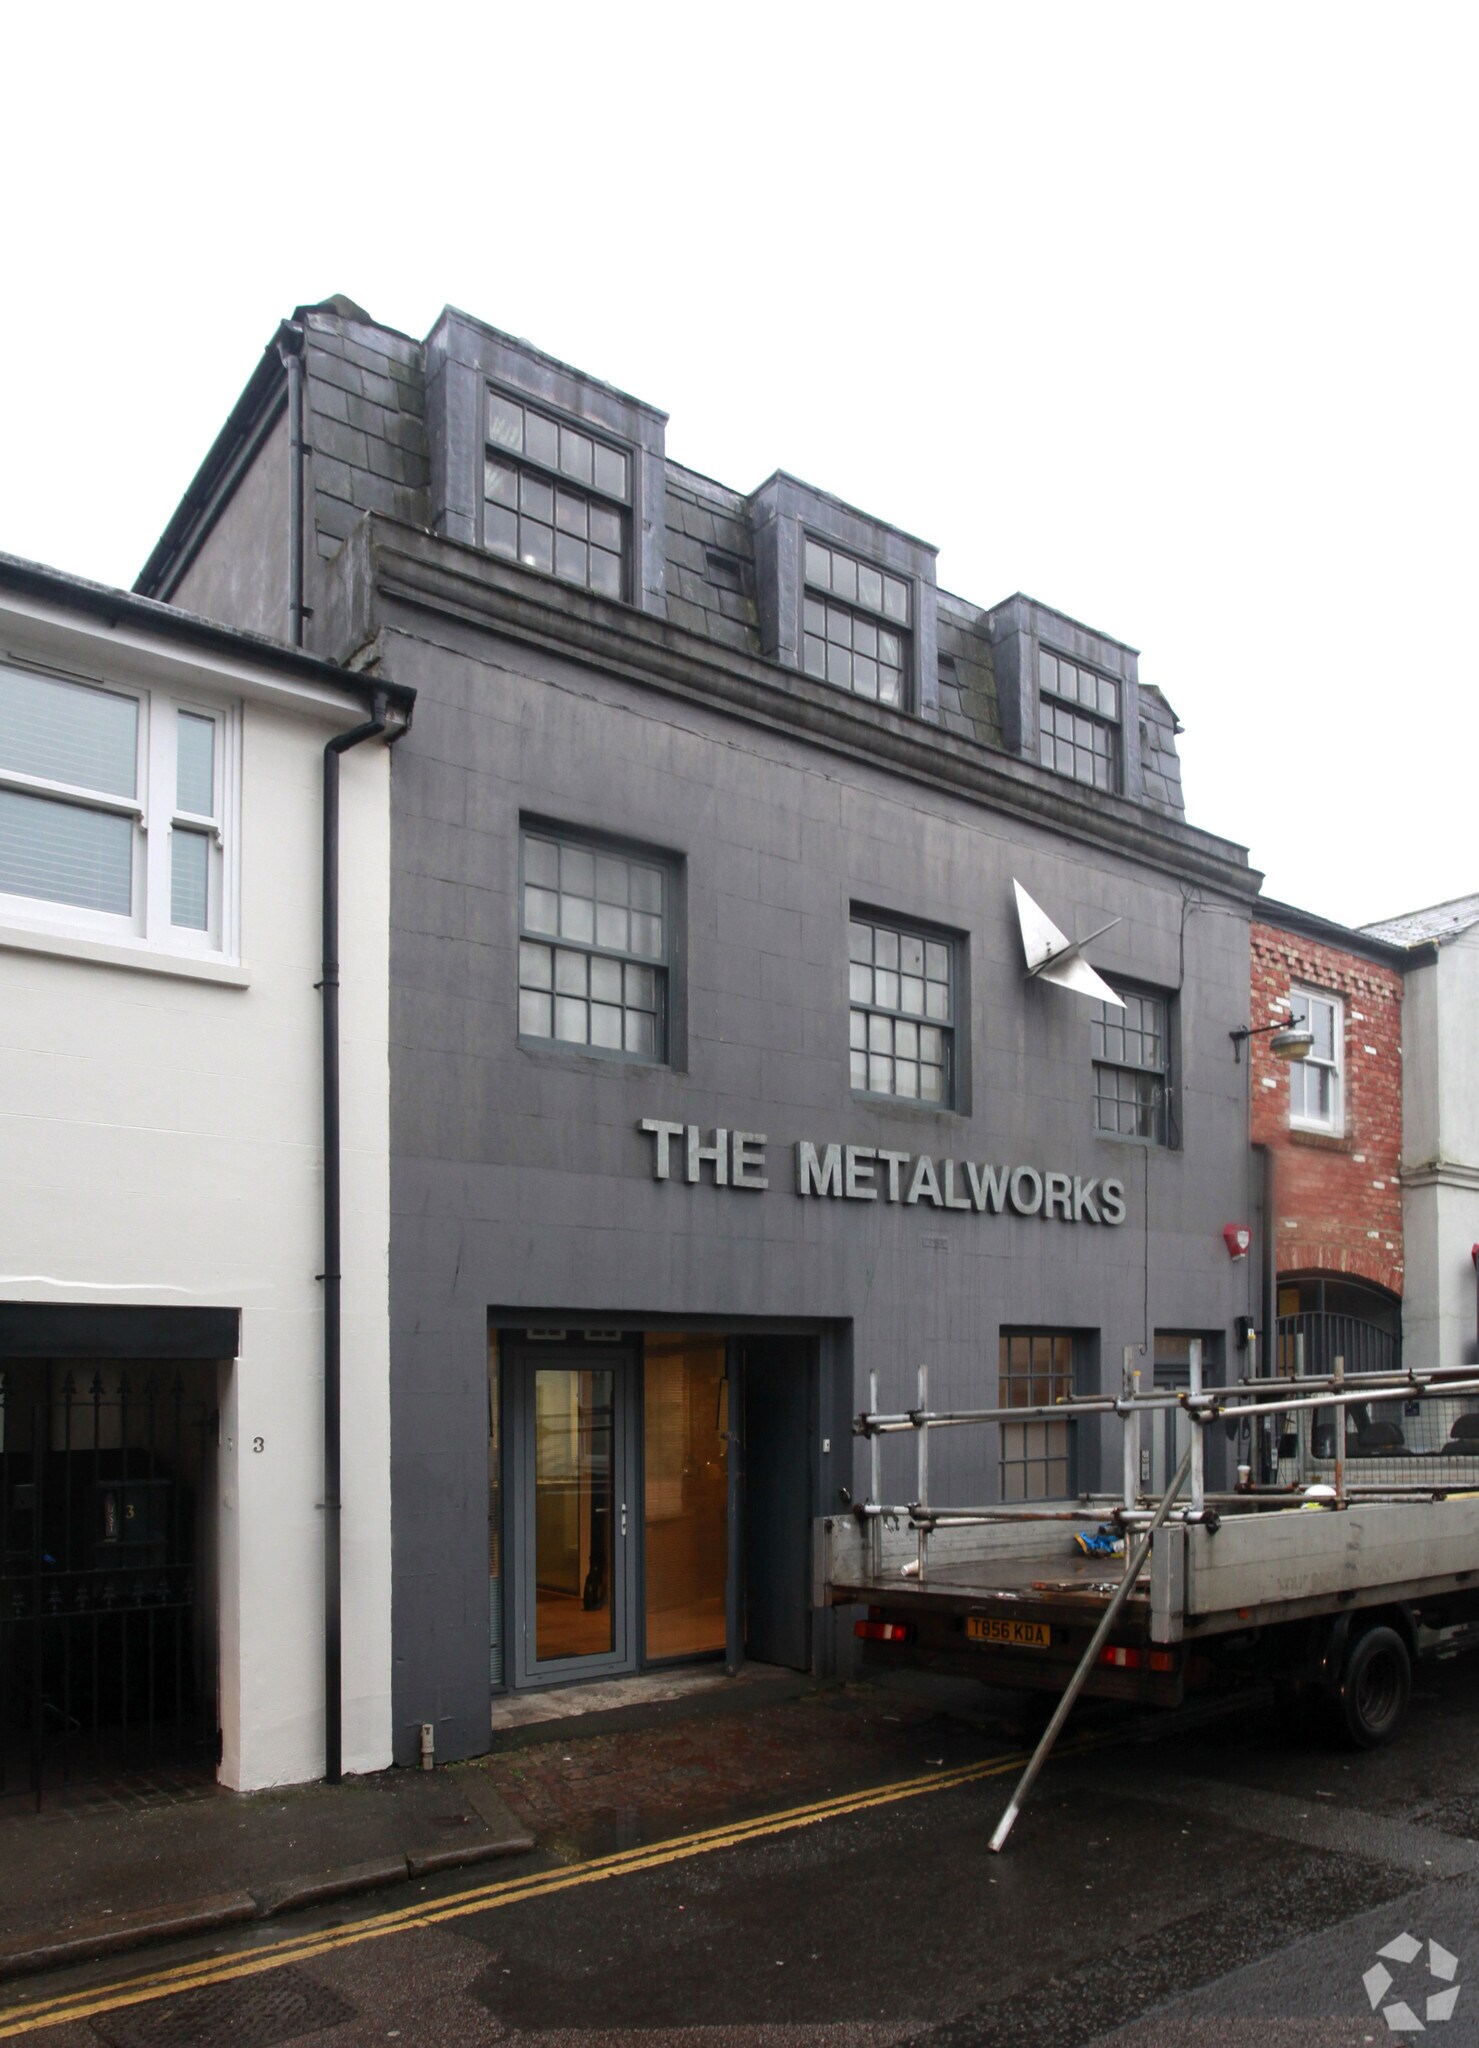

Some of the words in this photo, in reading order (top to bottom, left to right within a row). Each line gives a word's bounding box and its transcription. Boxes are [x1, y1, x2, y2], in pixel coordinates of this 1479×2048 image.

[638, 1118, 769, 1189] THE
[795, 1140, 1127, 1226] METALWORKS
[253, 1436, 265, 1454] 3
[126, 1504, 135, 1519] 3
[972, 1618, 1010, 1639] T856
[1014, 1622, 1044, 1643] KDA
